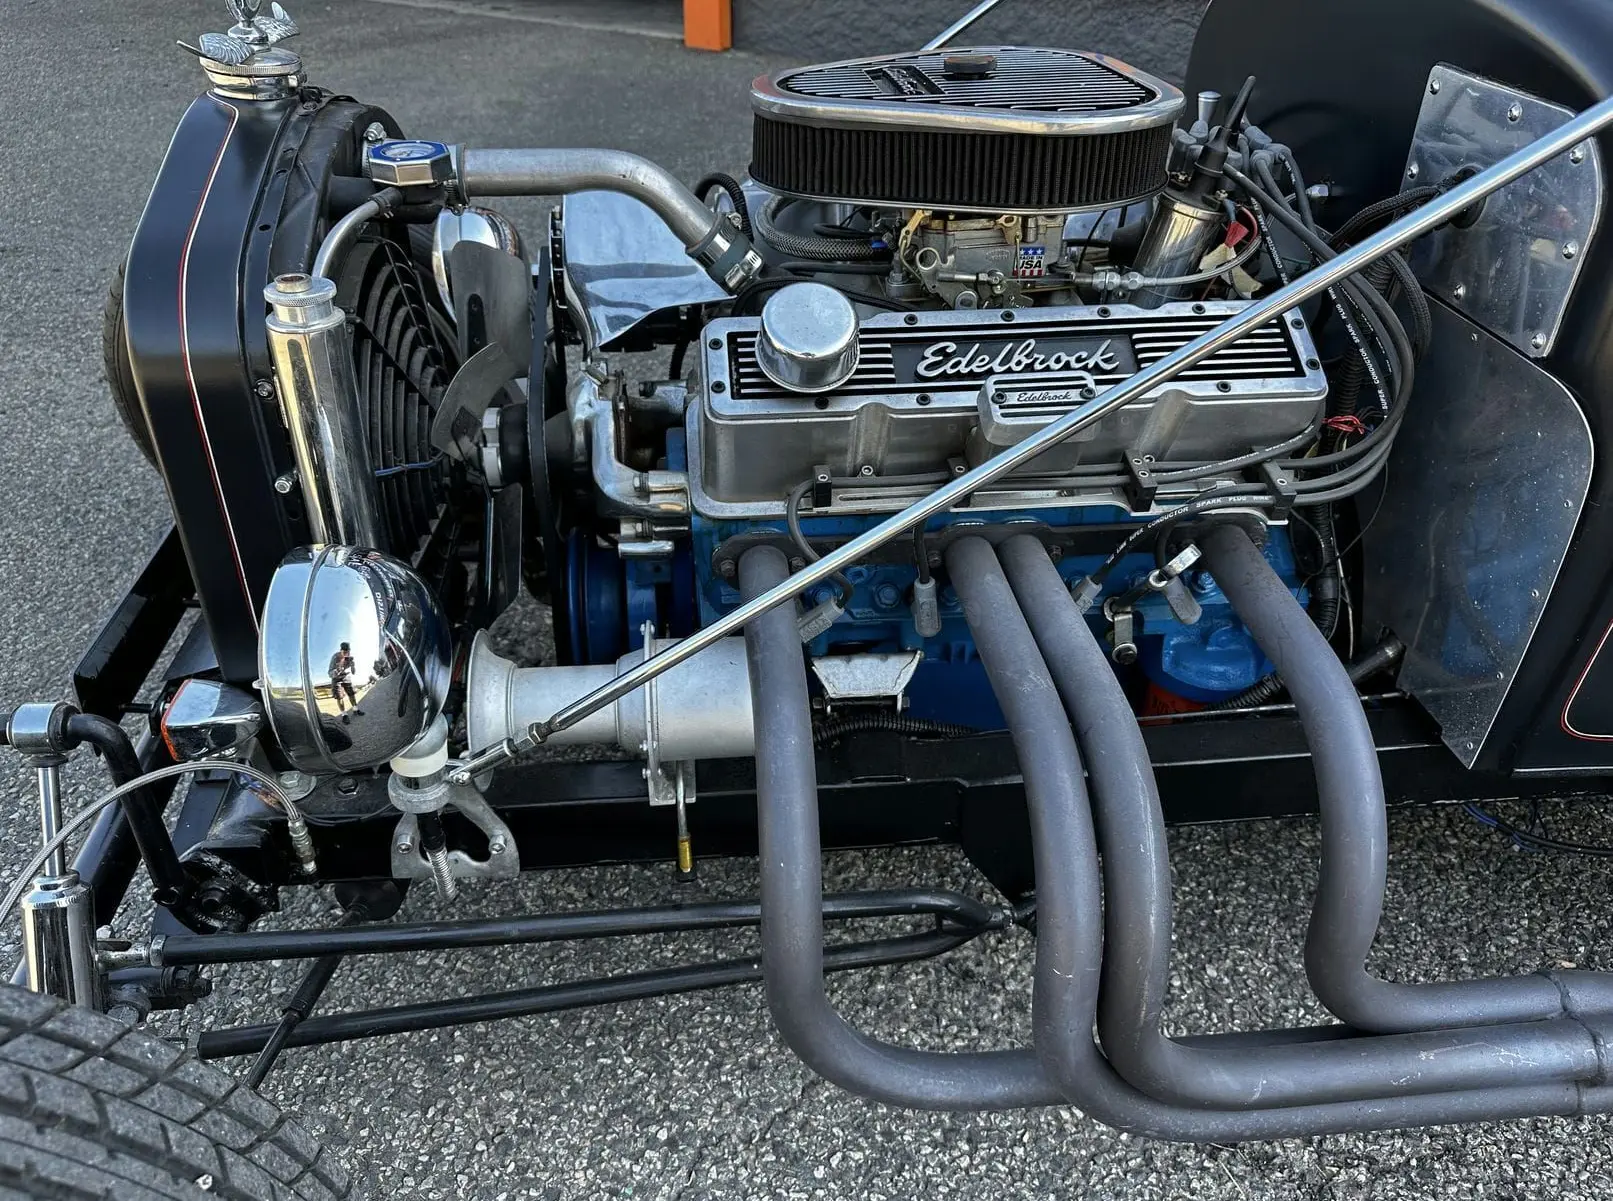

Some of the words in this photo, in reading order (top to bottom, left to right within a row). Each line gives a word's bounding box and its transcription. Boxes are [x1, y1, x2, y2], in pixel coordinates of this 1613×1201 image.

[1265, 236, 1283, 269] CONDUCTOR
[1335, 303, 1348, 320] PLUG
[1345, 323, 1361, 344] SPARK
[916, 338, 1119, 379] Edelbrock
[1358, 347, 1380, 385] CONDUCTOR
[1017, 391, 1072, 403] Edelbrock
[1377, 388, 1389, 410] SUPER
[1147, 505, 1190, 529] CONDUCTOR
[1196, 497, 1222, 508] SPARK
